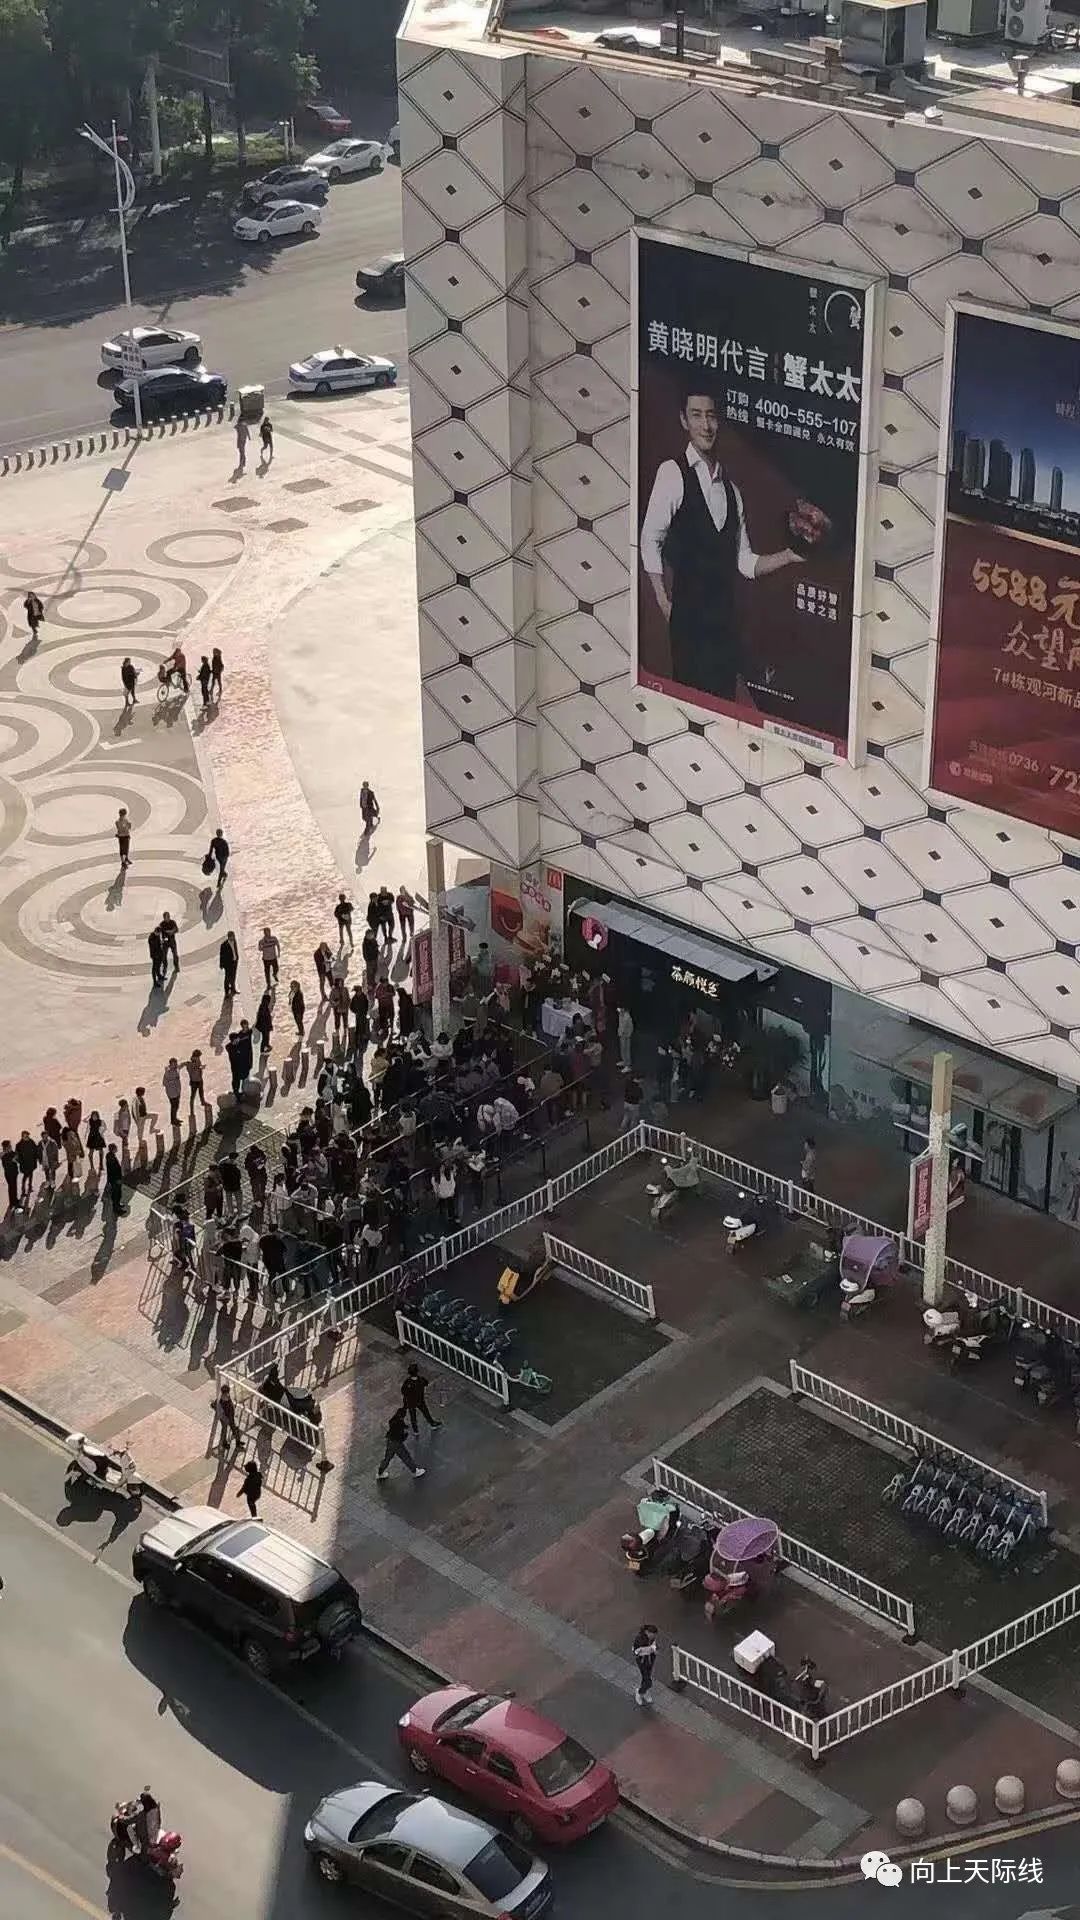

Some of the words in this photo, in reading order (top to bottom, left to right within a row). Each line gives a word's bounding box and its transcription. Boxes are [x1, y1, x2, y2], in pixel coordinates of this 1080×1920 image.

[647, 320, 769, 381] 黄晓明代言
[783, 352, 861, 403] 蟹太太
[726, 389, 749, 407] 订购
[726, 405, 749, 424] 热线
[755, 398, 857, 437] 4000-555-107
[1049, 765, 1080, 795] 72
